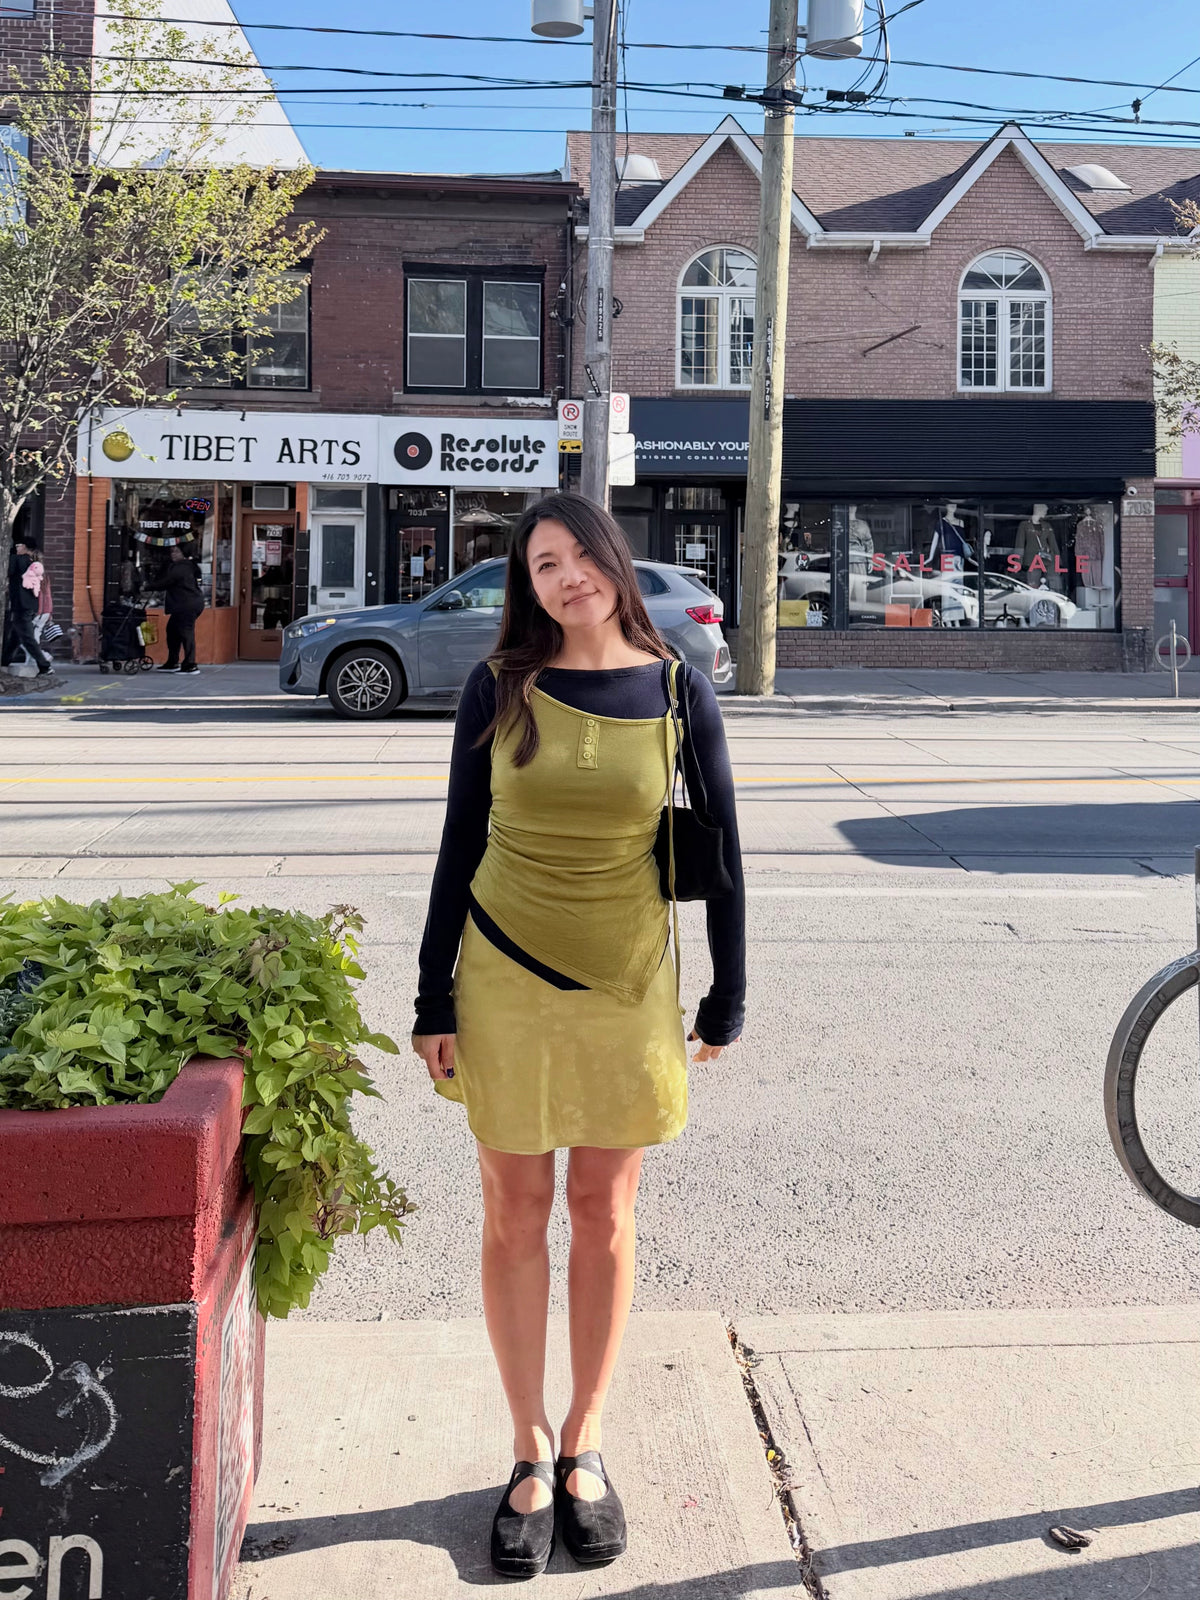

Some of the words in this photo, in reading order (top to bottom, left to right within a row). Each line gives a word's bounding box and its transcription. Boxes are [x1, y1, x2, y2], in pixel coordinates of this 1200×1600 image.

[160, 434, 258, 463] TIBET
[276, 437, 361, 466] ARTS
[440, 433, 546, 454] Resolute
[635, 440, 716, 450] ASHIONABLY
[717, 441, 749, 450] YOUR
[440, 452, 539, 473] Records
[185, 500, 210, 511] OPEN
[139, 520, 164, 528] TIBET
[167, 521, 191, 529] ARTS
[871, 553, 955, 572] SALE
[1007, 554, 1090, 573] SALE
